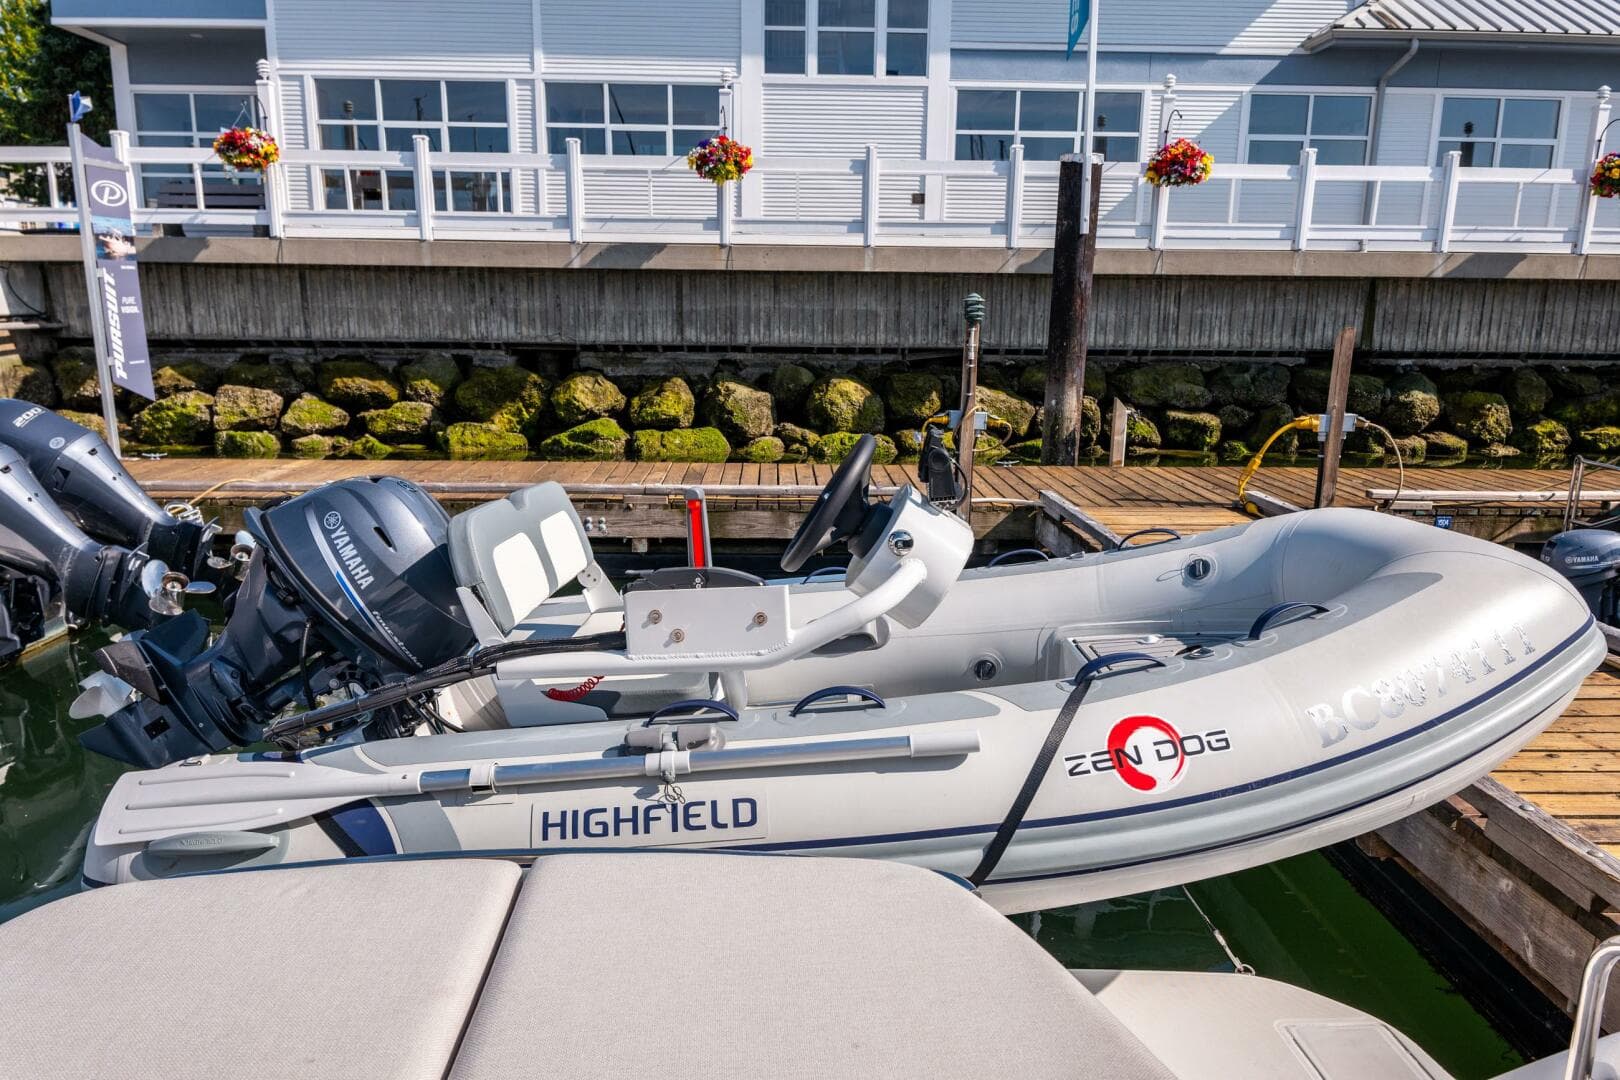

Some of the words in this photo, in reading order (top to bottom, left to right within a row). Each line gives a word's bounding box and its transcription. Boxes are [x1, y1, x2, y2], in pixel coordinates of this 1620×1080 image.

[102, 267, 128, 380] PURSUIT
[12, 406, 43, 428] 200
[330, 525, 375, 590] YAMAHA
[1573, 554, 1600, 564] YAMAHA
[1064, 744, 1143, 777] ZEN
[1152, 729, 1231, 762] DOG
[541, 796, 758, 842] HIGHFIELD
